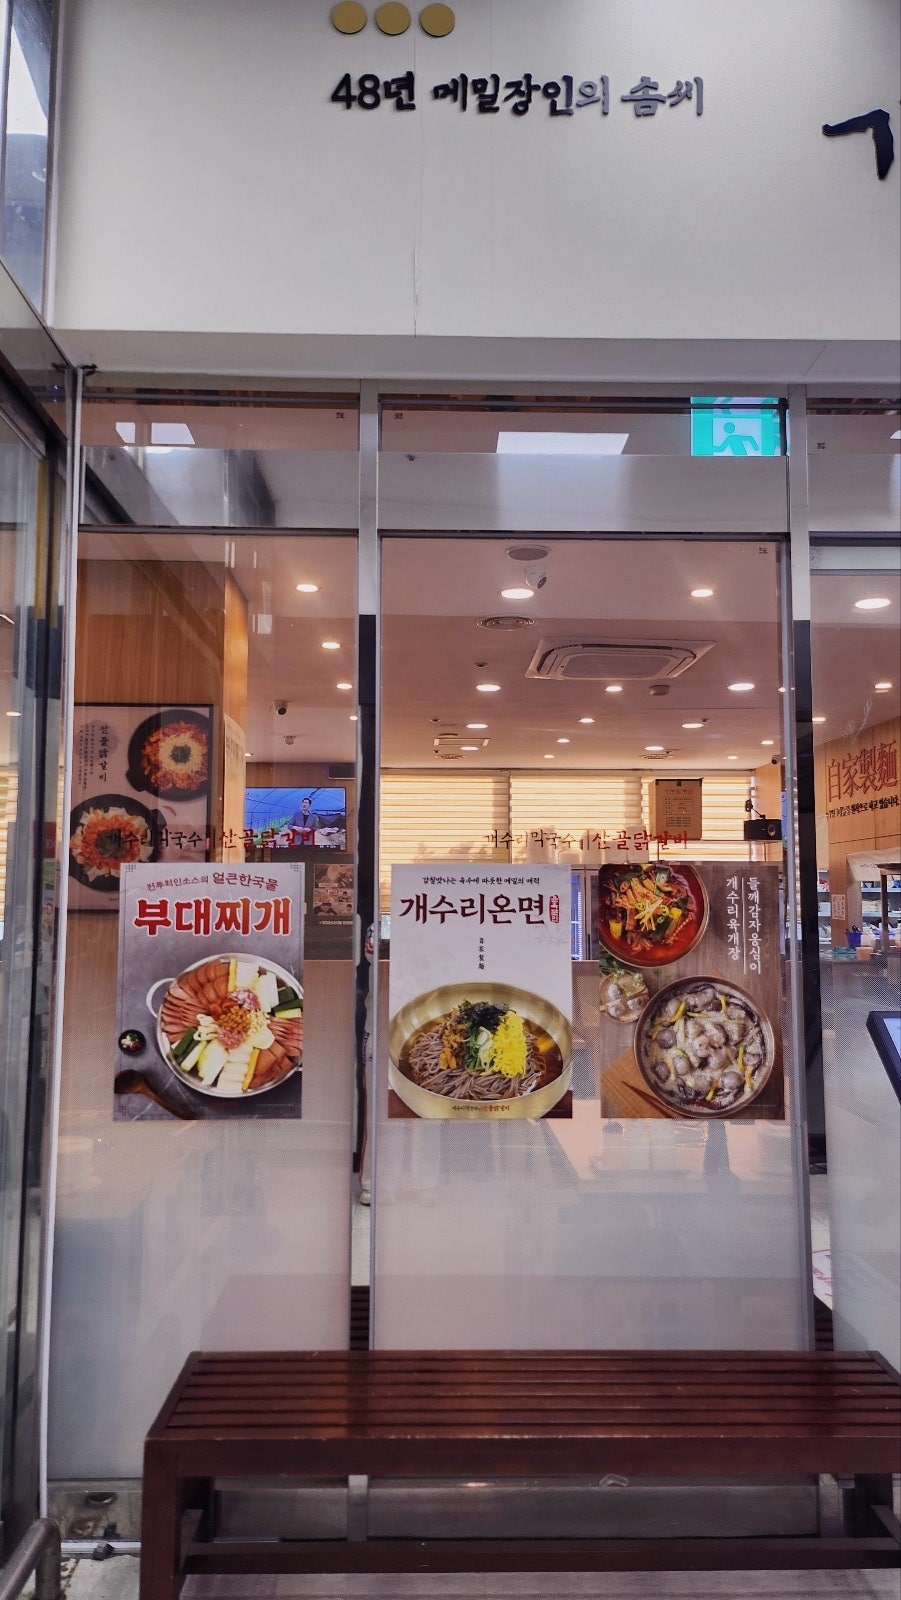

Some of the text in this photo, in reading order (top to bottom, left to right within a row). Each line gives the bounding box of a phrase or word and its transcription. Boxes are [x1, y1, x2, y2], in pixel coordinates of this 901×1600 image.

[330, 70, 704, 116] 48년 메밀장인의 솜씨
[483, 829, 688, 850] 개수리막국수 산골닭갈비
[134, 896, 293, 936] 부대찌개
[398, 892, 545, 925] 개수리온면
[726, 875, 741, 961] 개수리육개장
[746, 877, 762, 975] 들깨감자옹심이
